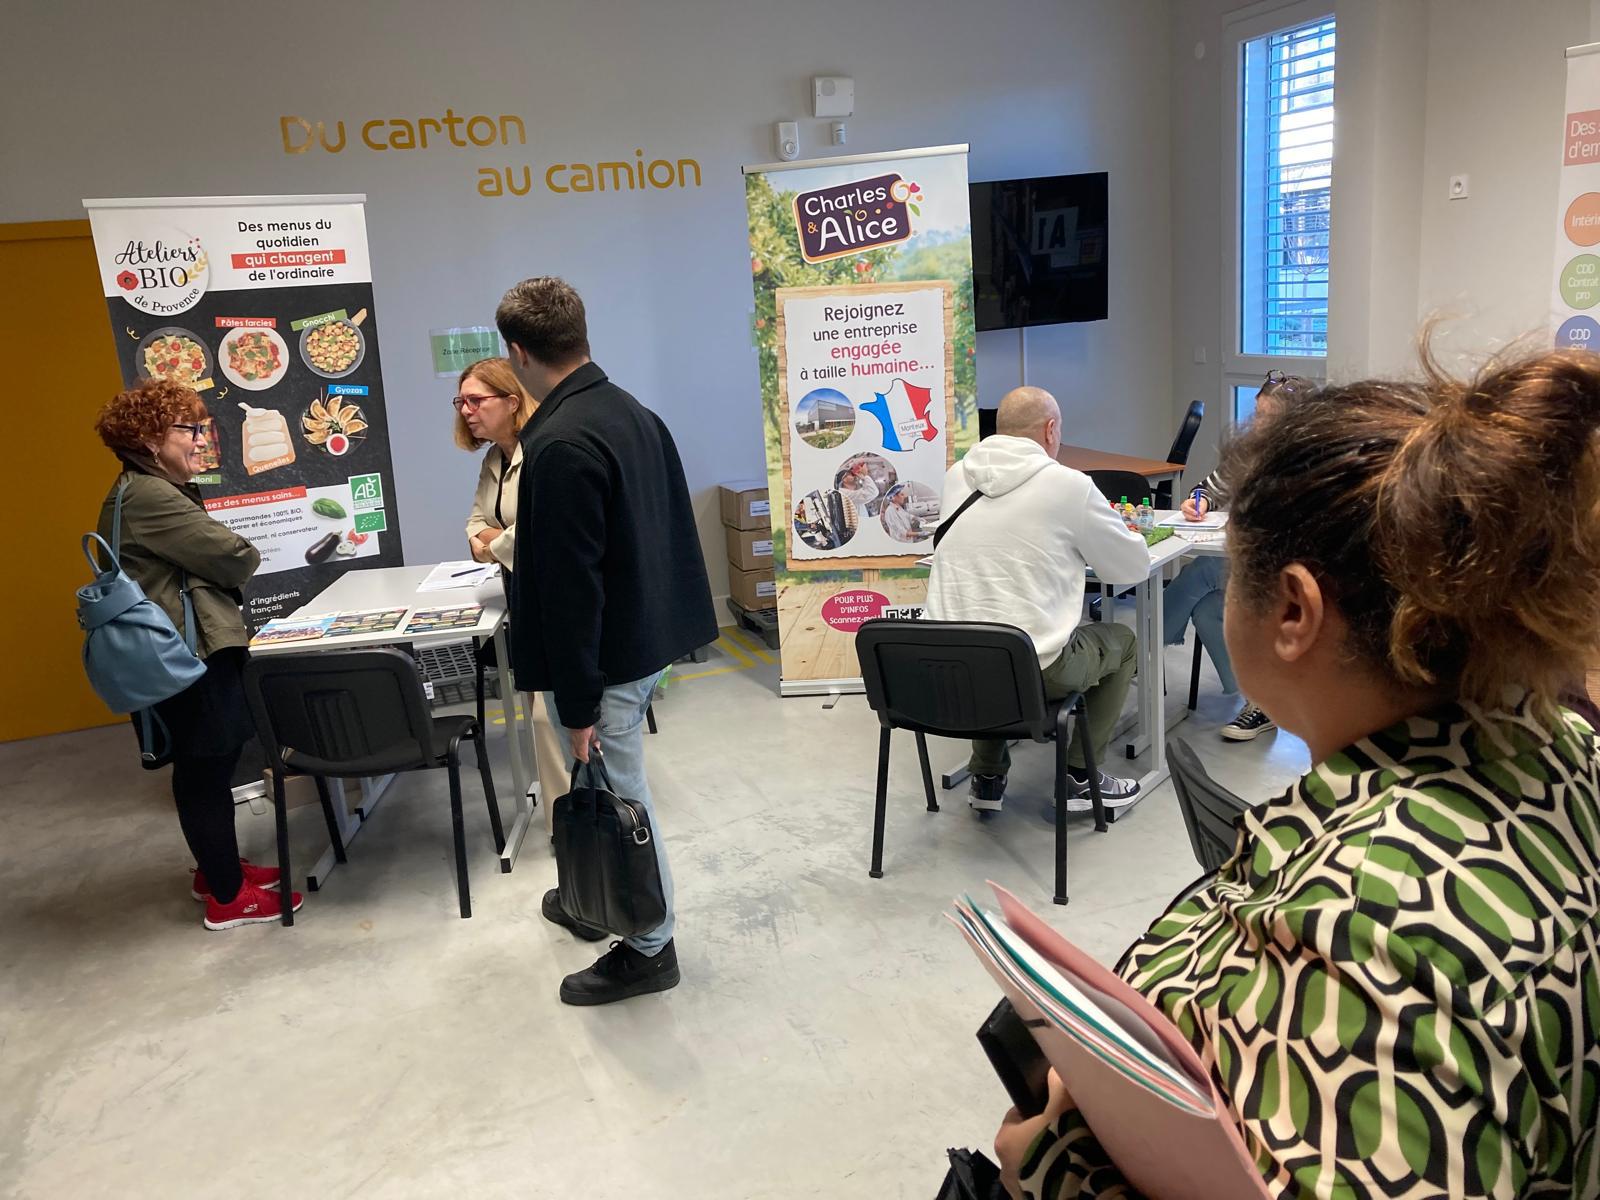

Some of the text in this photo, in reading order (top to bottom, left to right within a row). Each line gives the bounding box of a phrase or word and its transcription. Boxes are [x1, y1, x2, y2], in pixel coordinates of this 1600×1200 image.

[280, 108, 526, 154] Du carton
[1571, 120, 1596, 136] Des
[478, 148, 701, 197] au camion
[804, 186, 887, 216] Charles
[238, 219, 332, 232] Des menus du
[807, 215, 898, 251] & Alice
[256, 236, 319, 250] quotidien
[114, 240, 200, 265] Ateliers
[245, 251, 334, 267] qui changent
[137, 266, 188, 289] BIO
[248, 267, 335, 281] de l'ordinaire
[134, 287, 200, 313] de Provence
[302, 313, 336, 328] Gnocchi
[824, 303, 905, 322] Rejoignez
[221, 318, 273, 327] Pâtes farcies
[813, 322, 918, 342] une entreprise
[1569, 328, 1591, 341] CDD
[831, 340, 902, 360] engagée
[800, 358, 935, 381] à taille humaine...
[334, 386, 363, 395] Gyozas
[252, 457, 290, 473] Quenelles
[354, 482, 378, 499] AB
[223, 498, 240, 507] des
[241, 495, 271, 504] menus
[230, 513, 272, 525] gourmandes
[273, 509, 289, 518] 100%
[260, 515, 303, 528] économiques
[278, 526, 318, 538] conservateur
[250, 591, 300, 605] d'ingrédients
[834, 594, 874, 604] POUR PLUS
[250, 603, 283, 615] français
[840, 605, 869, 614] D'INFOS
